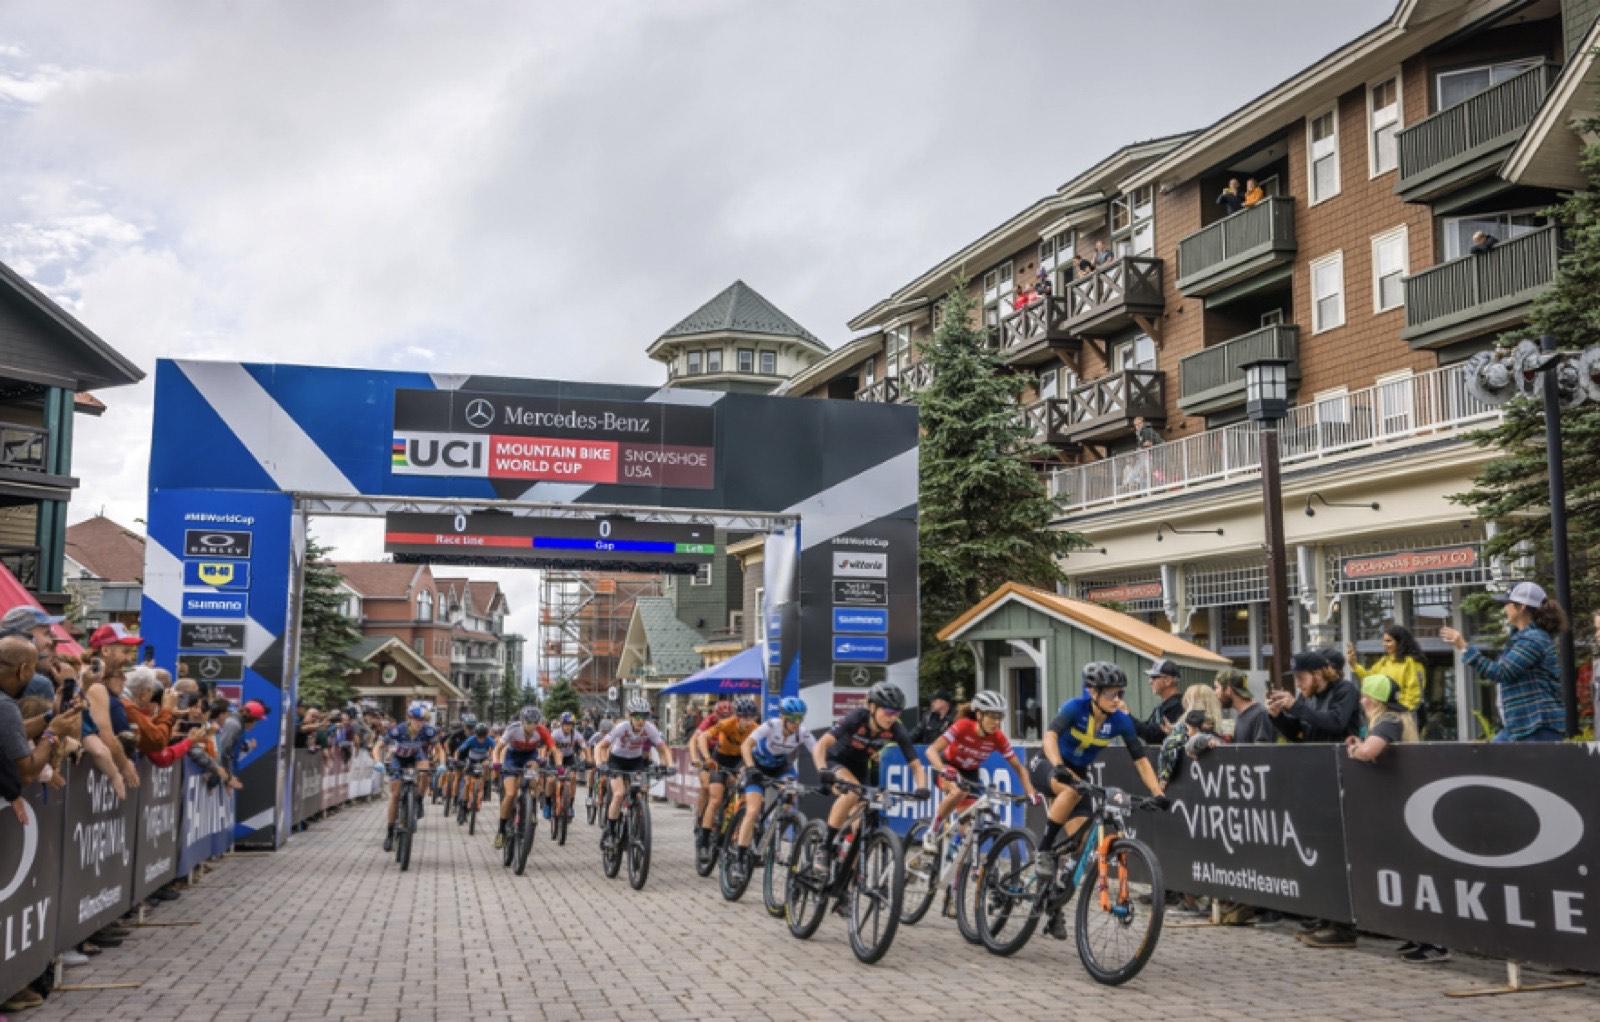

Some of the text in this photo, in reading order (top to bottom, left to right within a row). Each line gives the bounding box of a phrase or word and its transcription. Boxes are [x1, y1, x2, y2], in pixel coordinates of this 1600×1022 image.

[504, 404, 650, 433] Mercedes-Benz
[409, 439, 482, 469] UCI
[496, 443, 611, 461] MOUNTAIN BIKE
[624, 448, 707, 467] SNOWSHOE
[496, 459, 582, 474] WORLD CUP
[624, 465, 652, 478] USA
[454, 514, 467, 532] 0
[600, 521, 611, 538] 0
[435, 533, 460, 545] Race
[595, 540, 615, 550] Gap
[187, 600, 241, 611] SHIMANO
[1190, 761, 1270, 800] WEST
[1171, 799, 1318, 867] VIRGINIA
[1192, 861, 1300, 898] #AlmostHeaven
